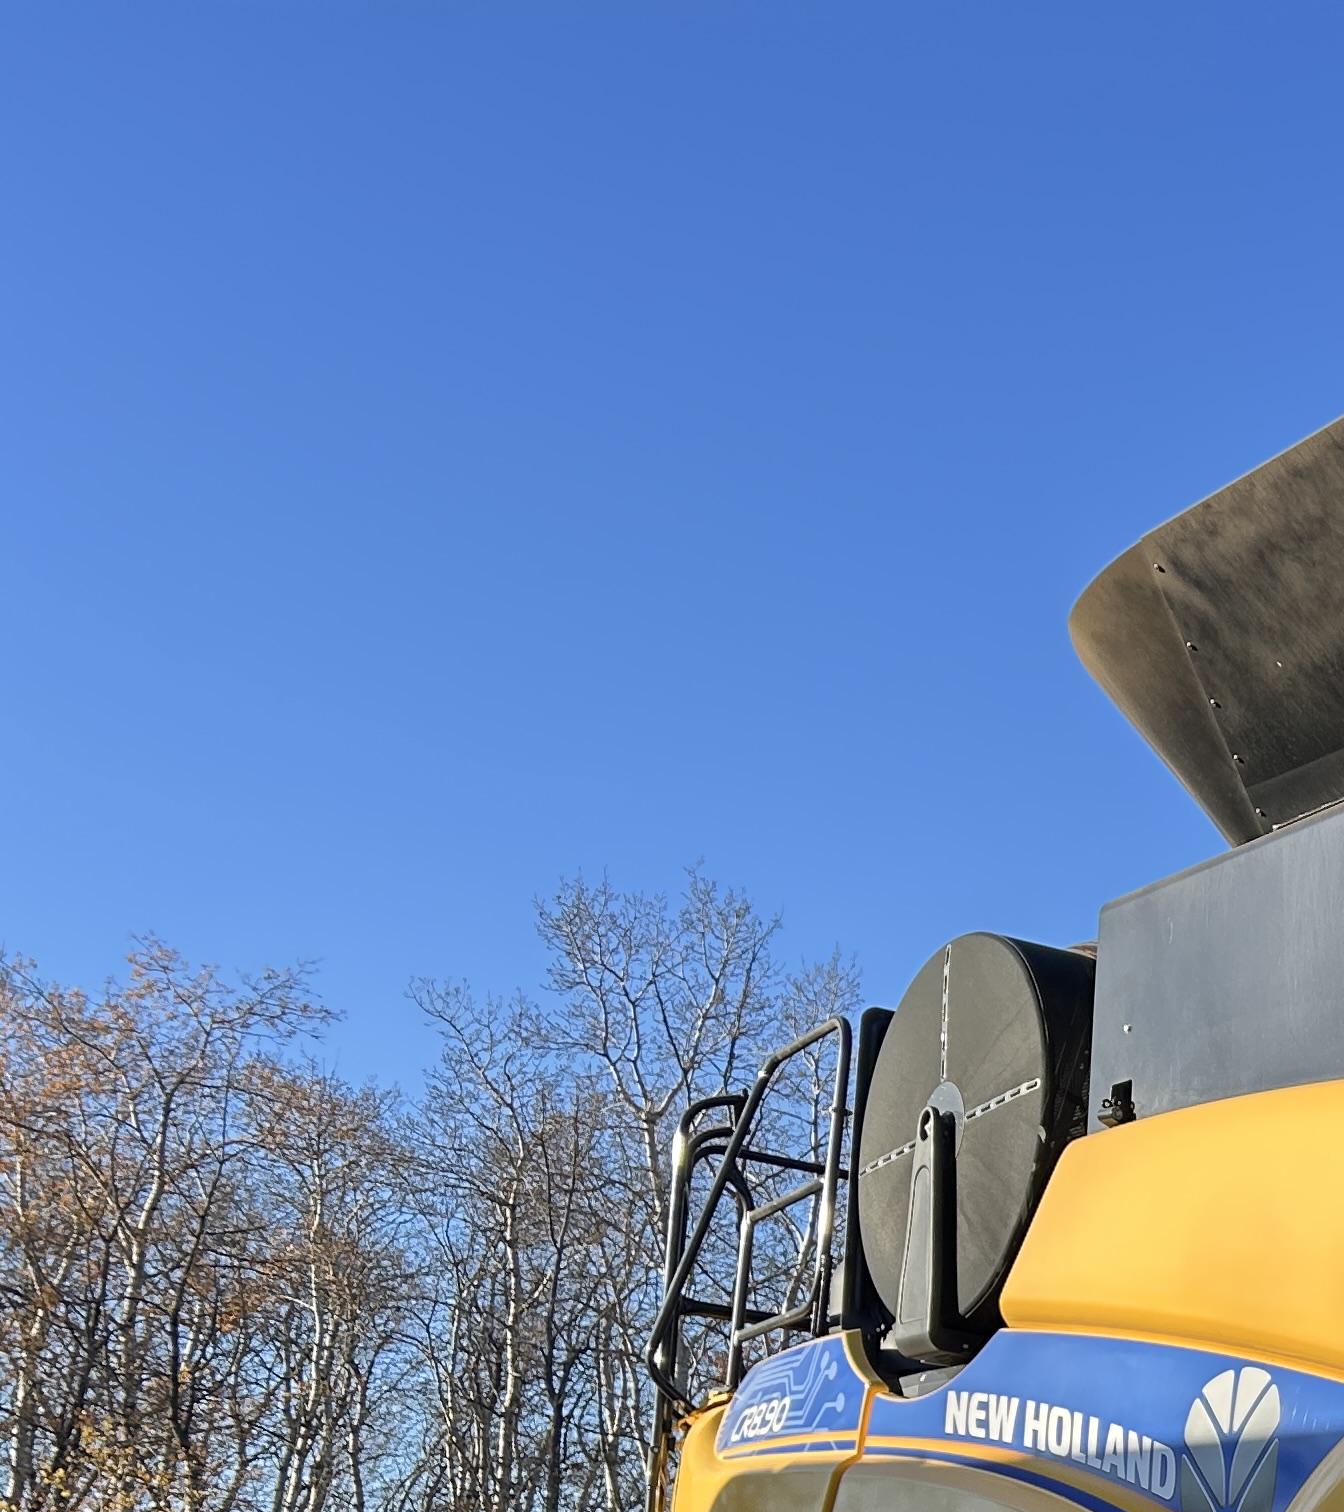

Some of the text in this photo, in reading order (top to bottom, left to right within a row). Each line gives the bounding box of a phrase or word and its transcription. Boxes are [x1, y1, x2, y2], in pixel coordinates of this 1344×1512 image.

[731, 1396, 791, 1442] CR8.90
[944, 1390, 1176, 1500] NEW HOLLAND
